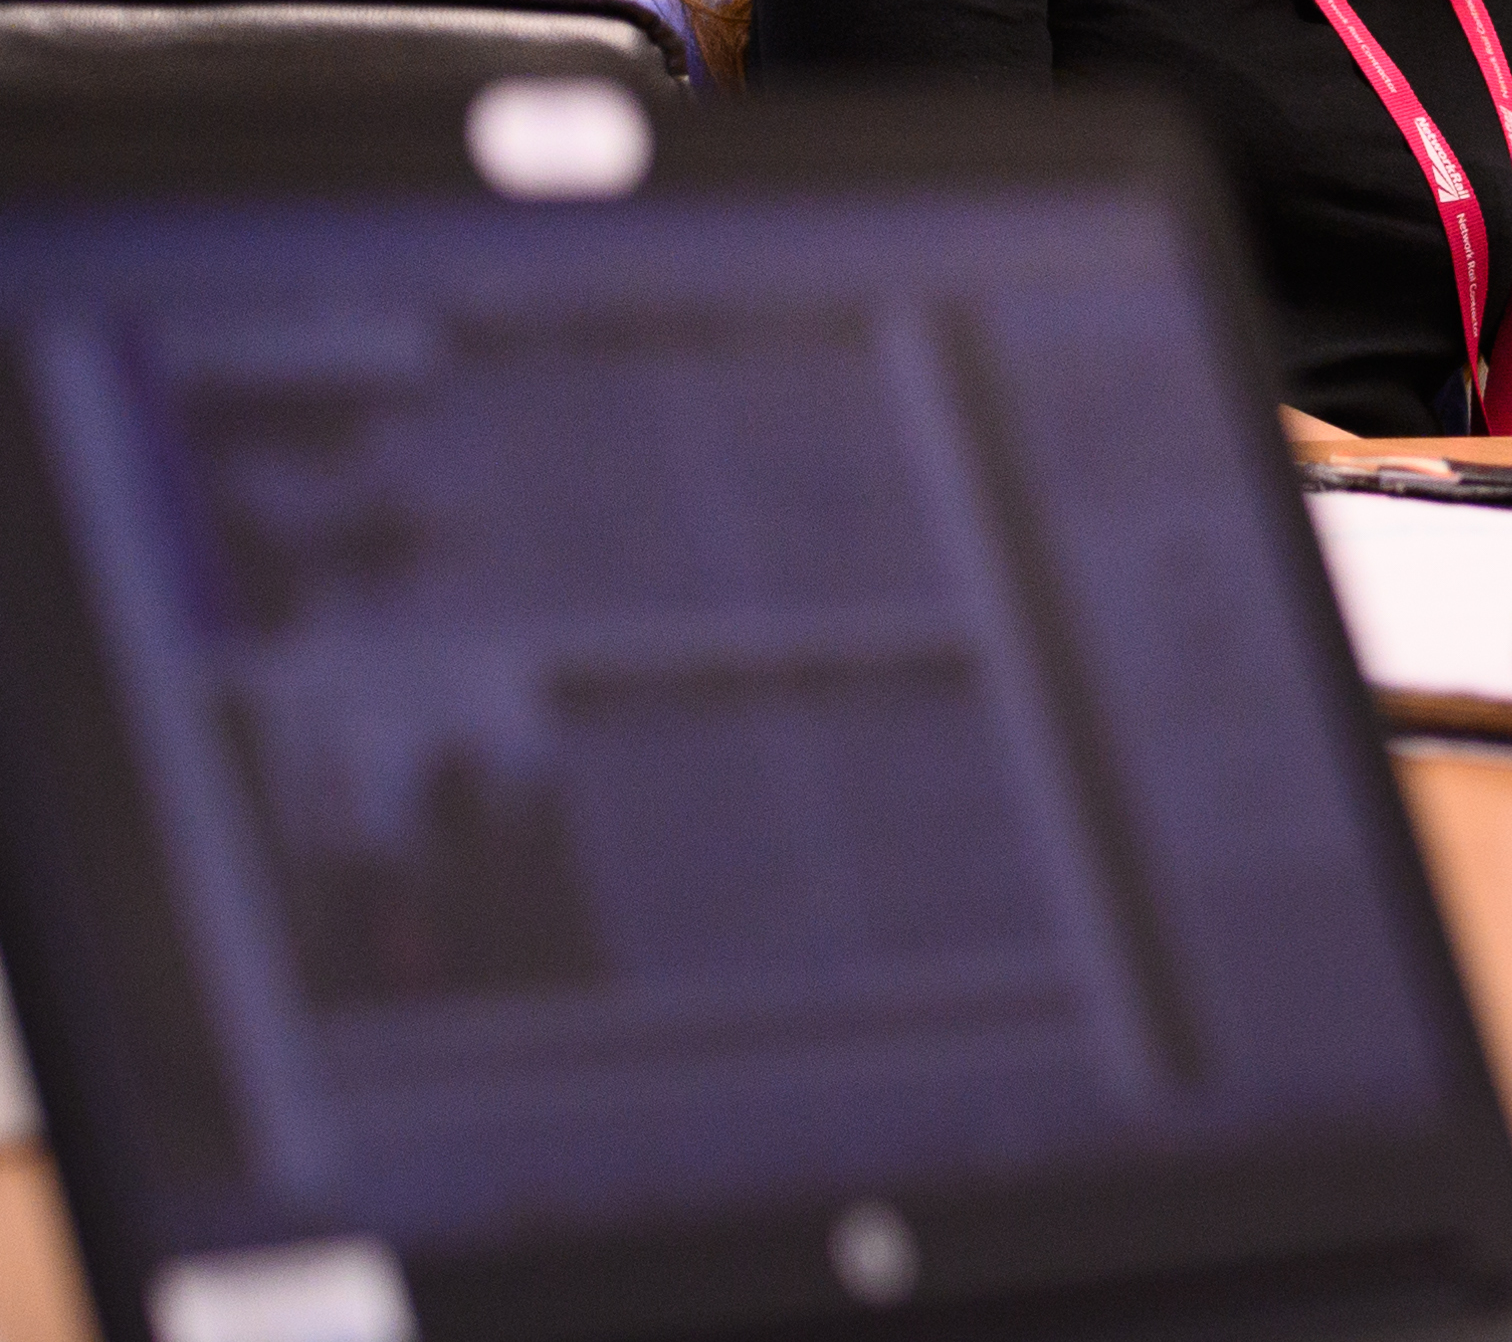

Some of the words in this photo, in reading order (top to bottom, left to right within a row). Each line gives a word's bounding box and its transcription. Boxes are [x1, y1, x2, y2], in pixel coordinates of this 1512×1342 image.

[1361, 43, 1397, 94] Contractor
[1415, 116, 1471, 201] NetworkRail
[1456, 212, 1476, 261] Network
[1467, 260, 1477, 283] Rail
